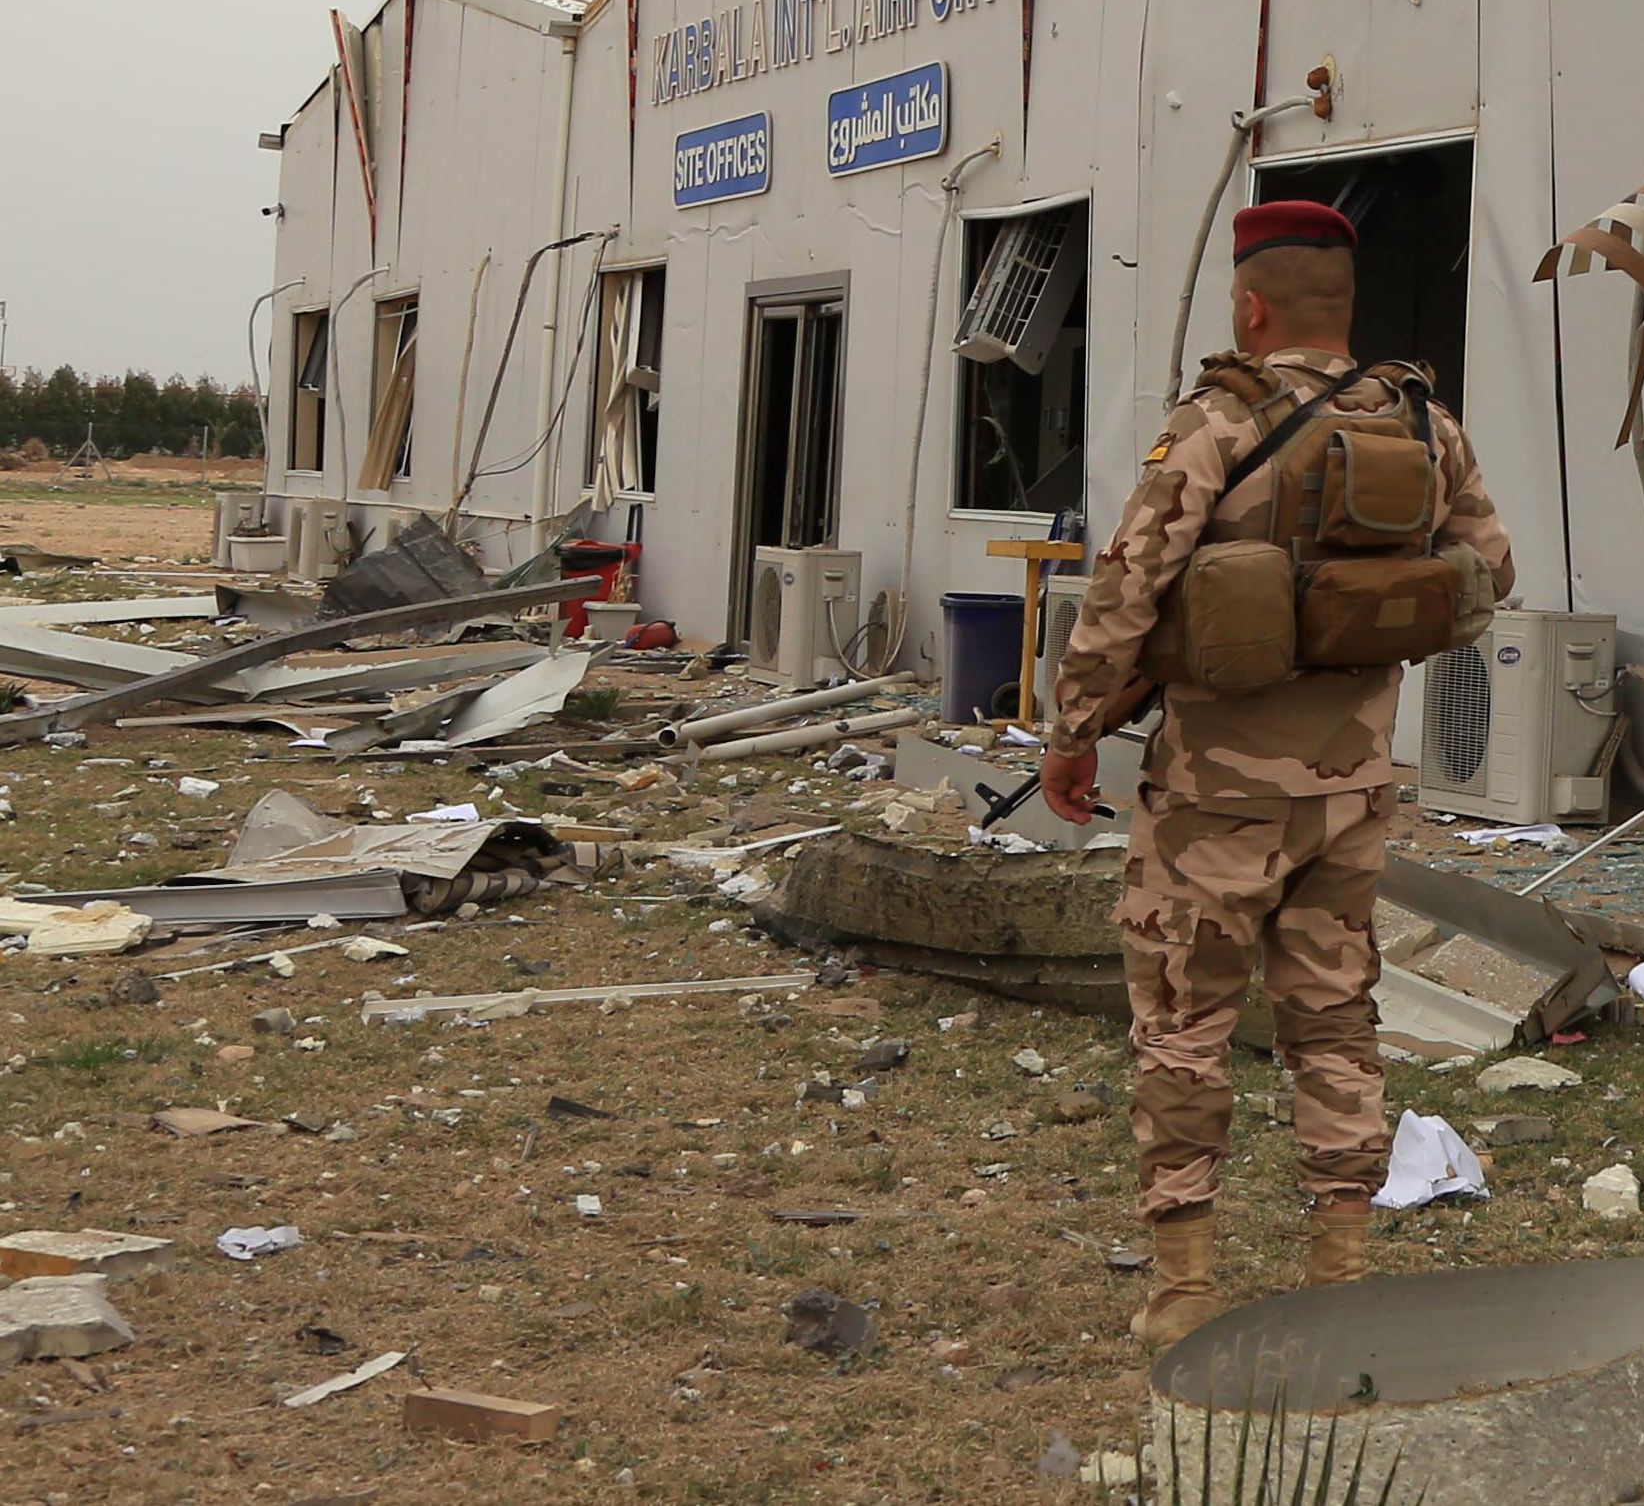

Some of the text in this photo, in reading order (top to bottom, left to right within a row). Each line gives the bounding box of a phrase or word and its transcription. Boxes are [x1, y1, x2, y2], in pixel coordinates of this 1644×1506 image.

[675, 128, 766, 192] SITE OFFICES
[829, 78, 940, 167] مكاتب المشروع
